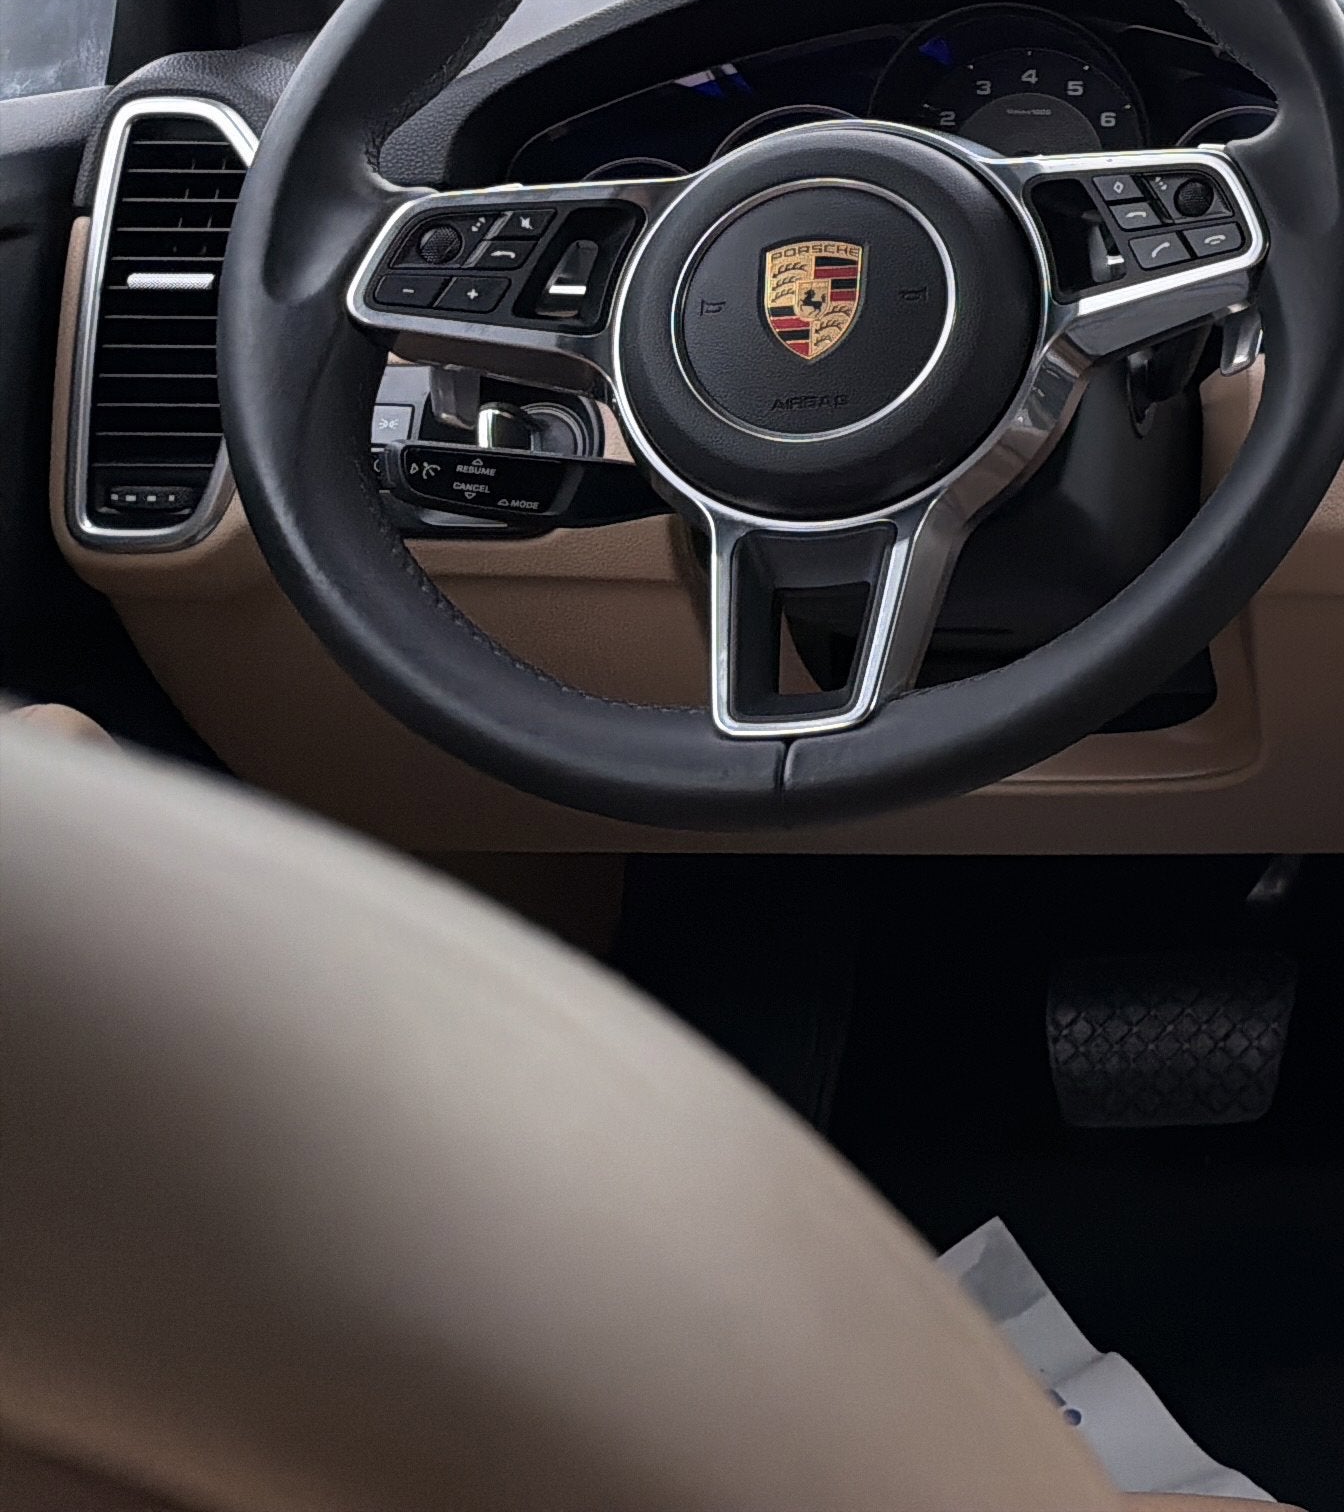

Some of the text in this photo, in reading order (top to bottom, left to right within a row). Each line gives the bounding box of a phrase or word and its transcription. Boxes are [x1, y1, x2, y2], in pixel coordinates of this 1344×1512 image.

[1021, 68, 1039, 85] 4
[975, 80, 992, 96] 3
[1066, 80, 1084, 96] 5
[939, 111, 956, 126] 2
[1100, 112, 1116, 127] 6
[770, 243, 862, 264] PORSCHE
[769, 395, 850, 412] AIRBAG
[456, 464, 497, 477] RESUME
[453, 480, 491, 494] CANCEL
[511, 499, 540, 510] MODE
